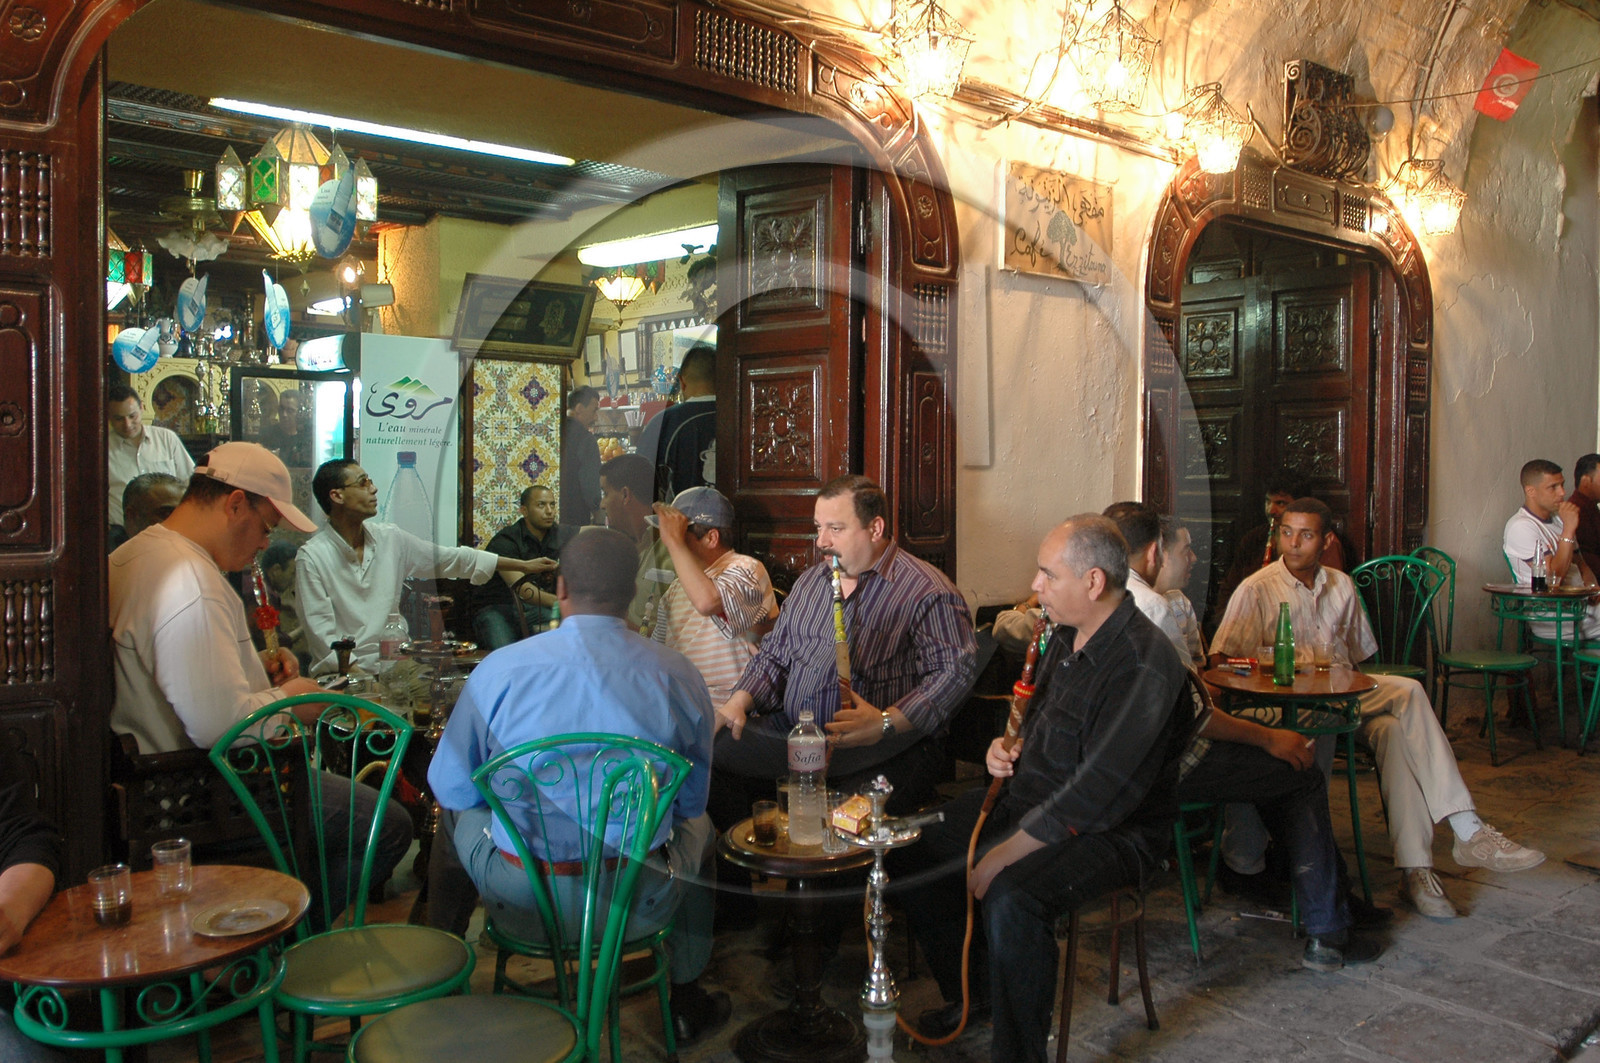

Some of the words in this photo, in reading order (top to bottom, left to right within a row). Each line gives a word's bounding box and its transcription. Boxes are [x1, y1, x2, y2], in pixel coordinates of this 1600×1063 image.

[1010, 220, 1053, 268] Café
[378, 422, 406, 433] L'eau
[408, 426, 443, 434] minérale
[365, 436, 427, 445] naturellement
[793, 751, 822, 766] Safia
